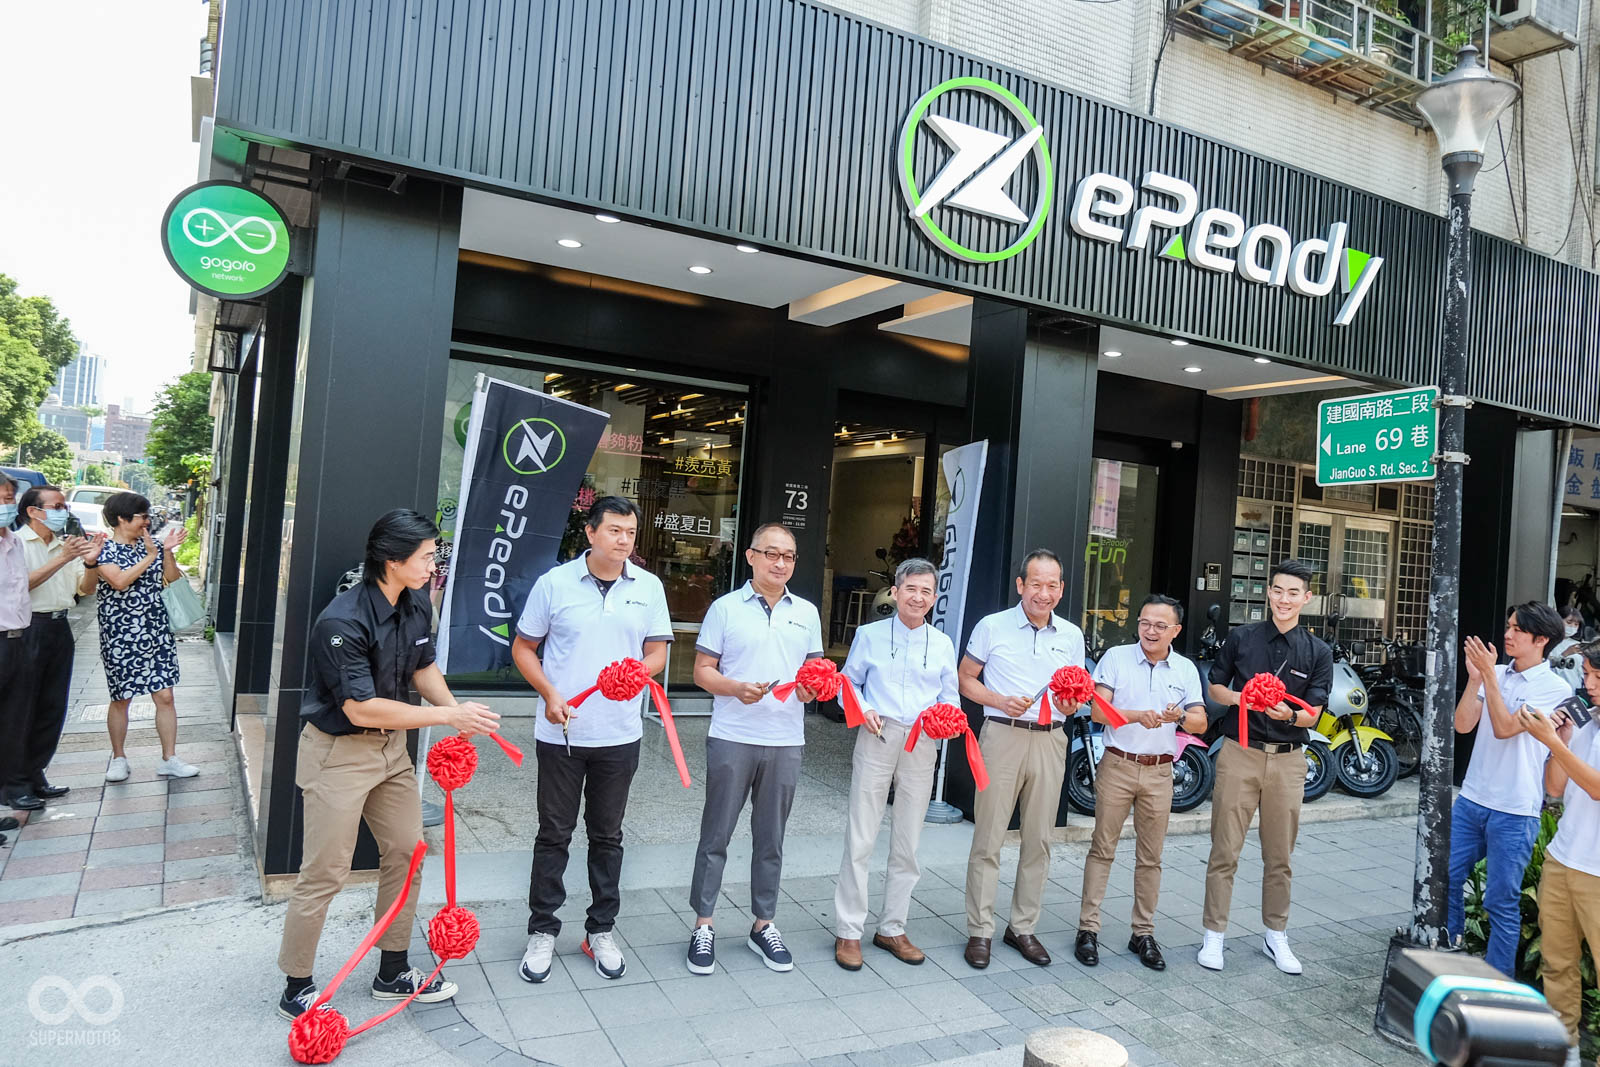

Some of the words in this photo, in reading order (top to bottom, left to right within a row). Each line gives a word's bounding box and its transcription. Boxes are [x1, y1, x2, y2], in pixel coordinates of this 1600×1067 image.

[1070, 171, 1384, 326] eReady
[200, 256, 256, 272] gogoro
[212, 273, 244, 281] network
[1326, 393, 1429, 425] 建國南路二段
[1336, 443, 1366, 455] Lane
[1375, 428, 1403, 451] 69
[1411, 424, 1429, 447] 巷
[1329, 466, 1366, 480] JianGuo
[1369, 464, 1377, 476] S.
[1380, 463, 1396, 476] Rd.
[1398, 461, 1419, 474] Sec.
[1422, 460, 1428, 473] 2
[784, 490, 808, 510] 73
[654, 513, 711, 534] #盛夏白
[479, 485, 528, 646] eReady
